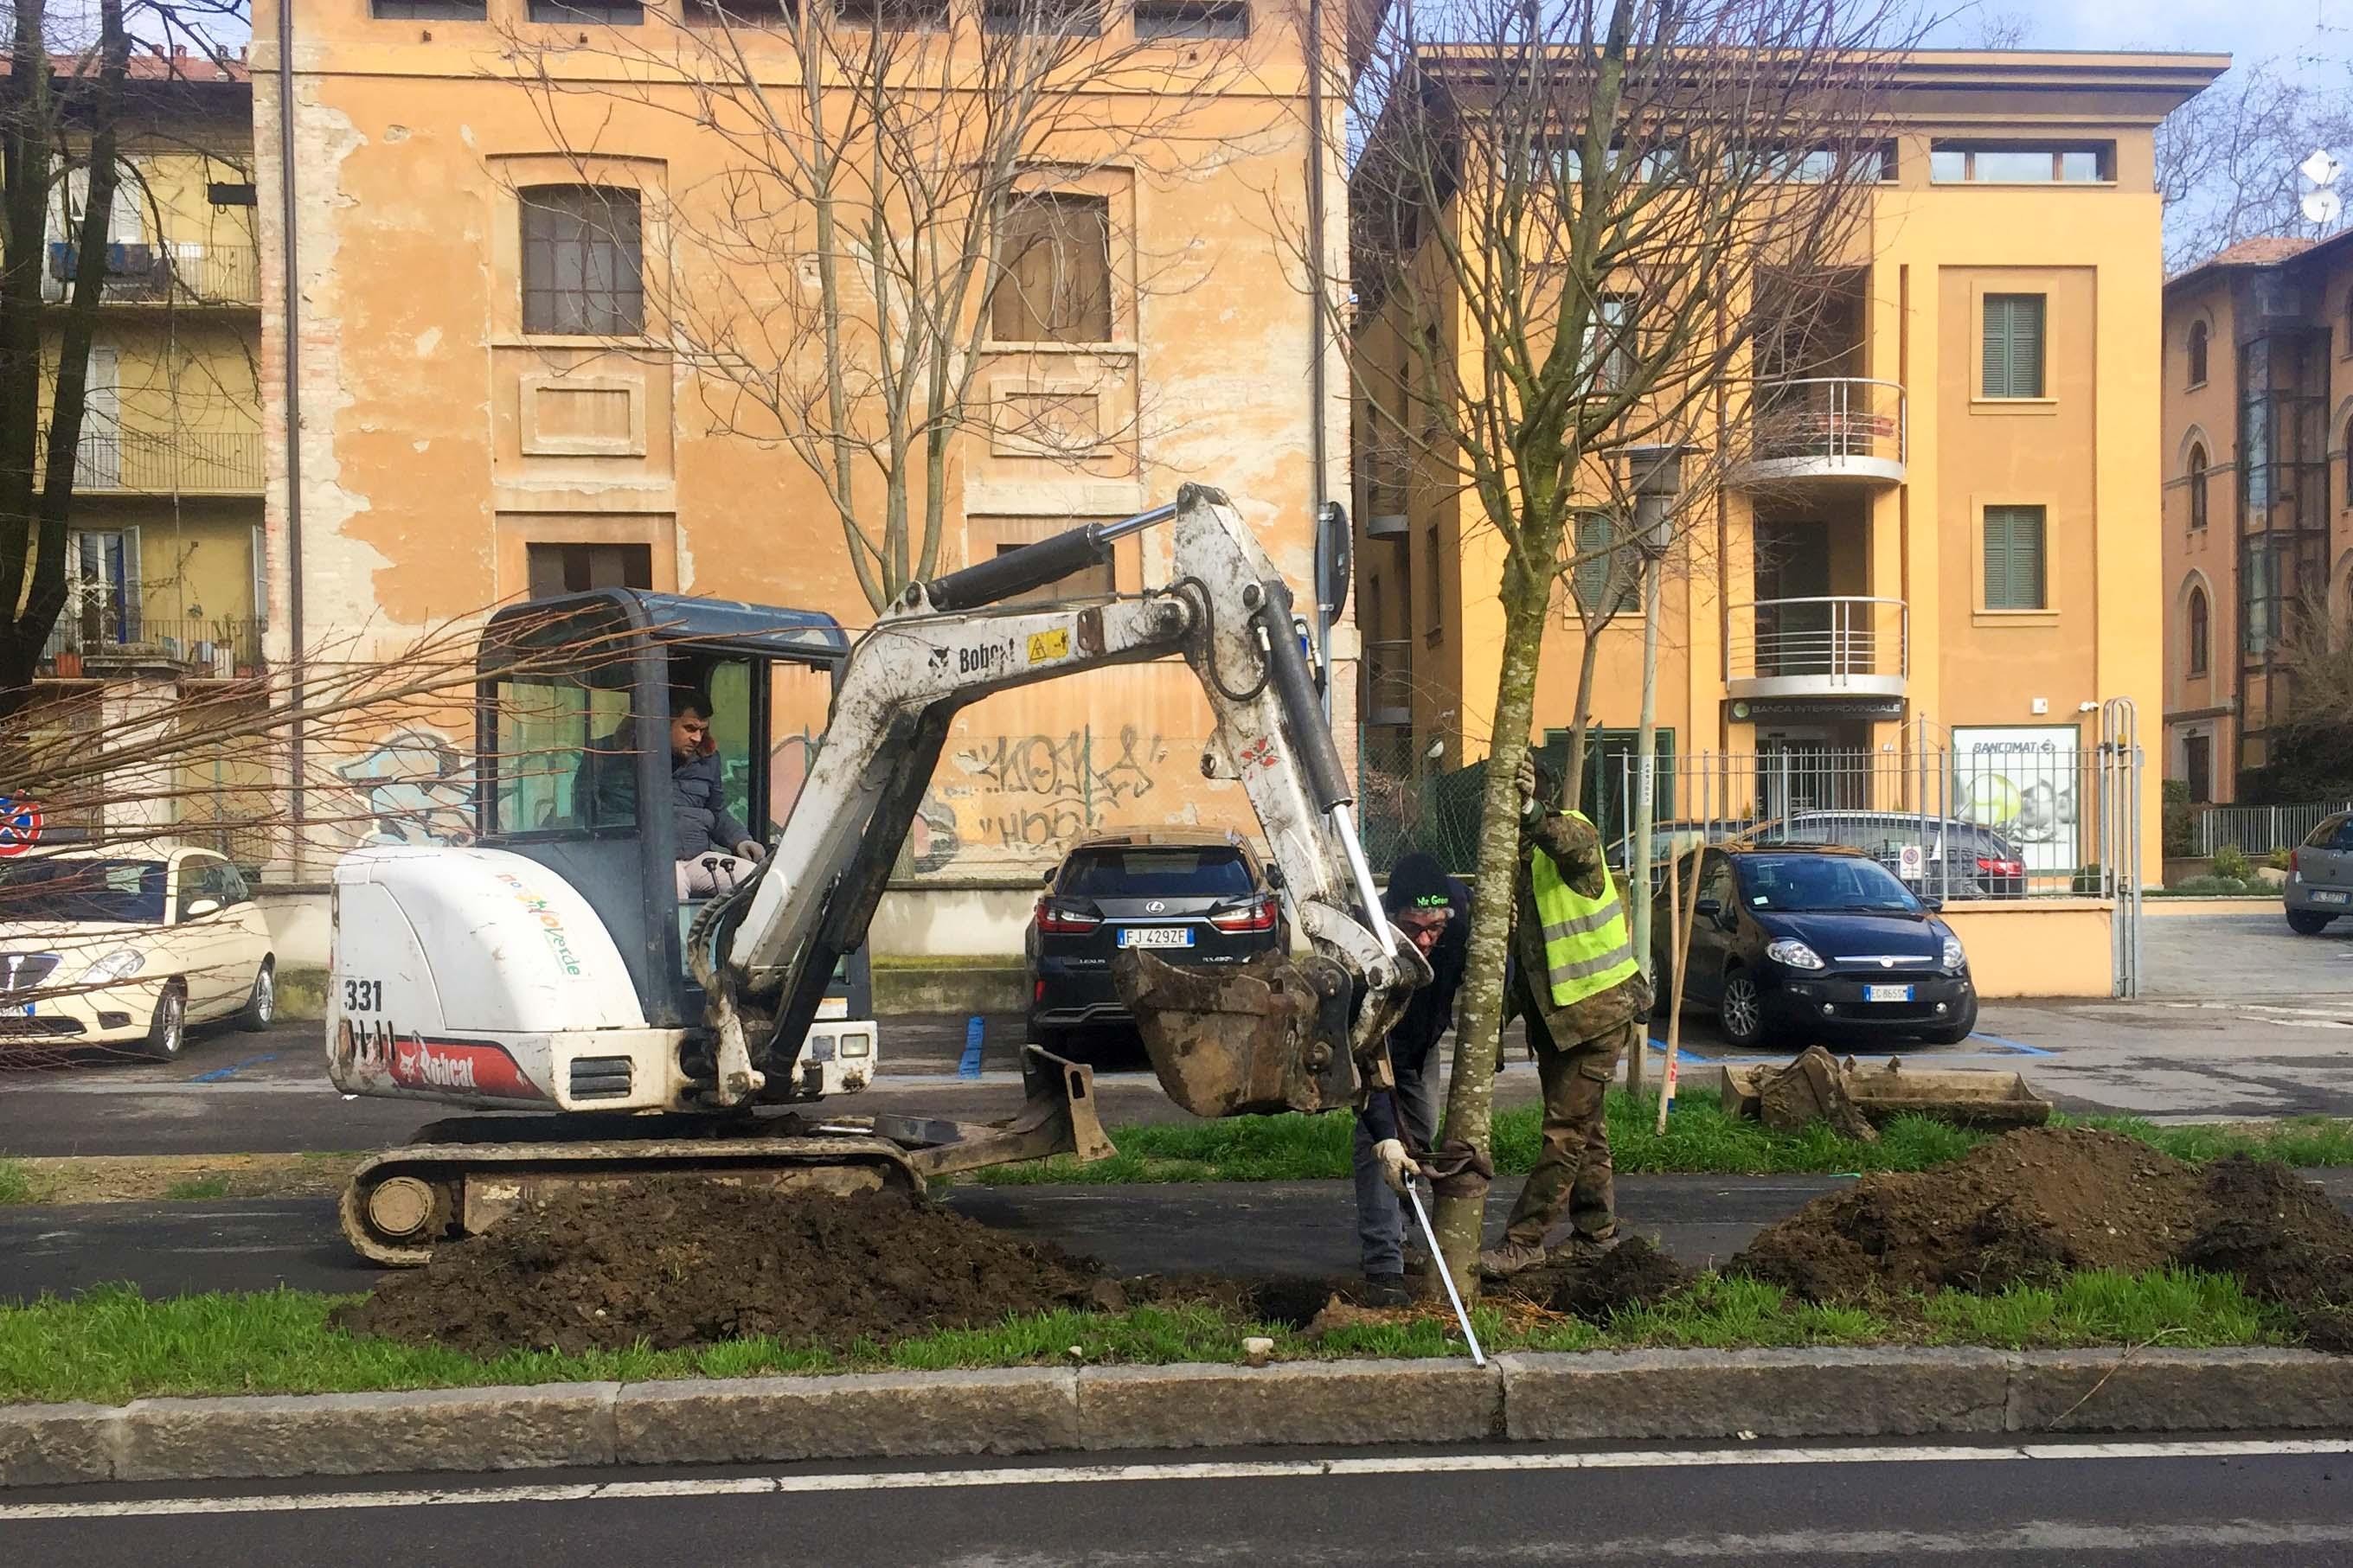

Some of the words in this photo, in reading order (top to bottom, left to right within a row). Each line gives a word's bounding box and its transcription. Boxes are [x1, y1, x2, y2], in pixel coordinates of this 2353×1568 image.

[1752, 705, 1792, 714] BANCA
[1793, 704, 1901, 714] INTERPROVINCIALE
[1972, 742, 2037, 753] BANCOMAT
[1416, 896, 1429, 907] Mr
[1126, 931, 1142, 944] FJ
[1146, 930, 1185, 944] 429ZF
[344, 979, 382, 1012] 331
